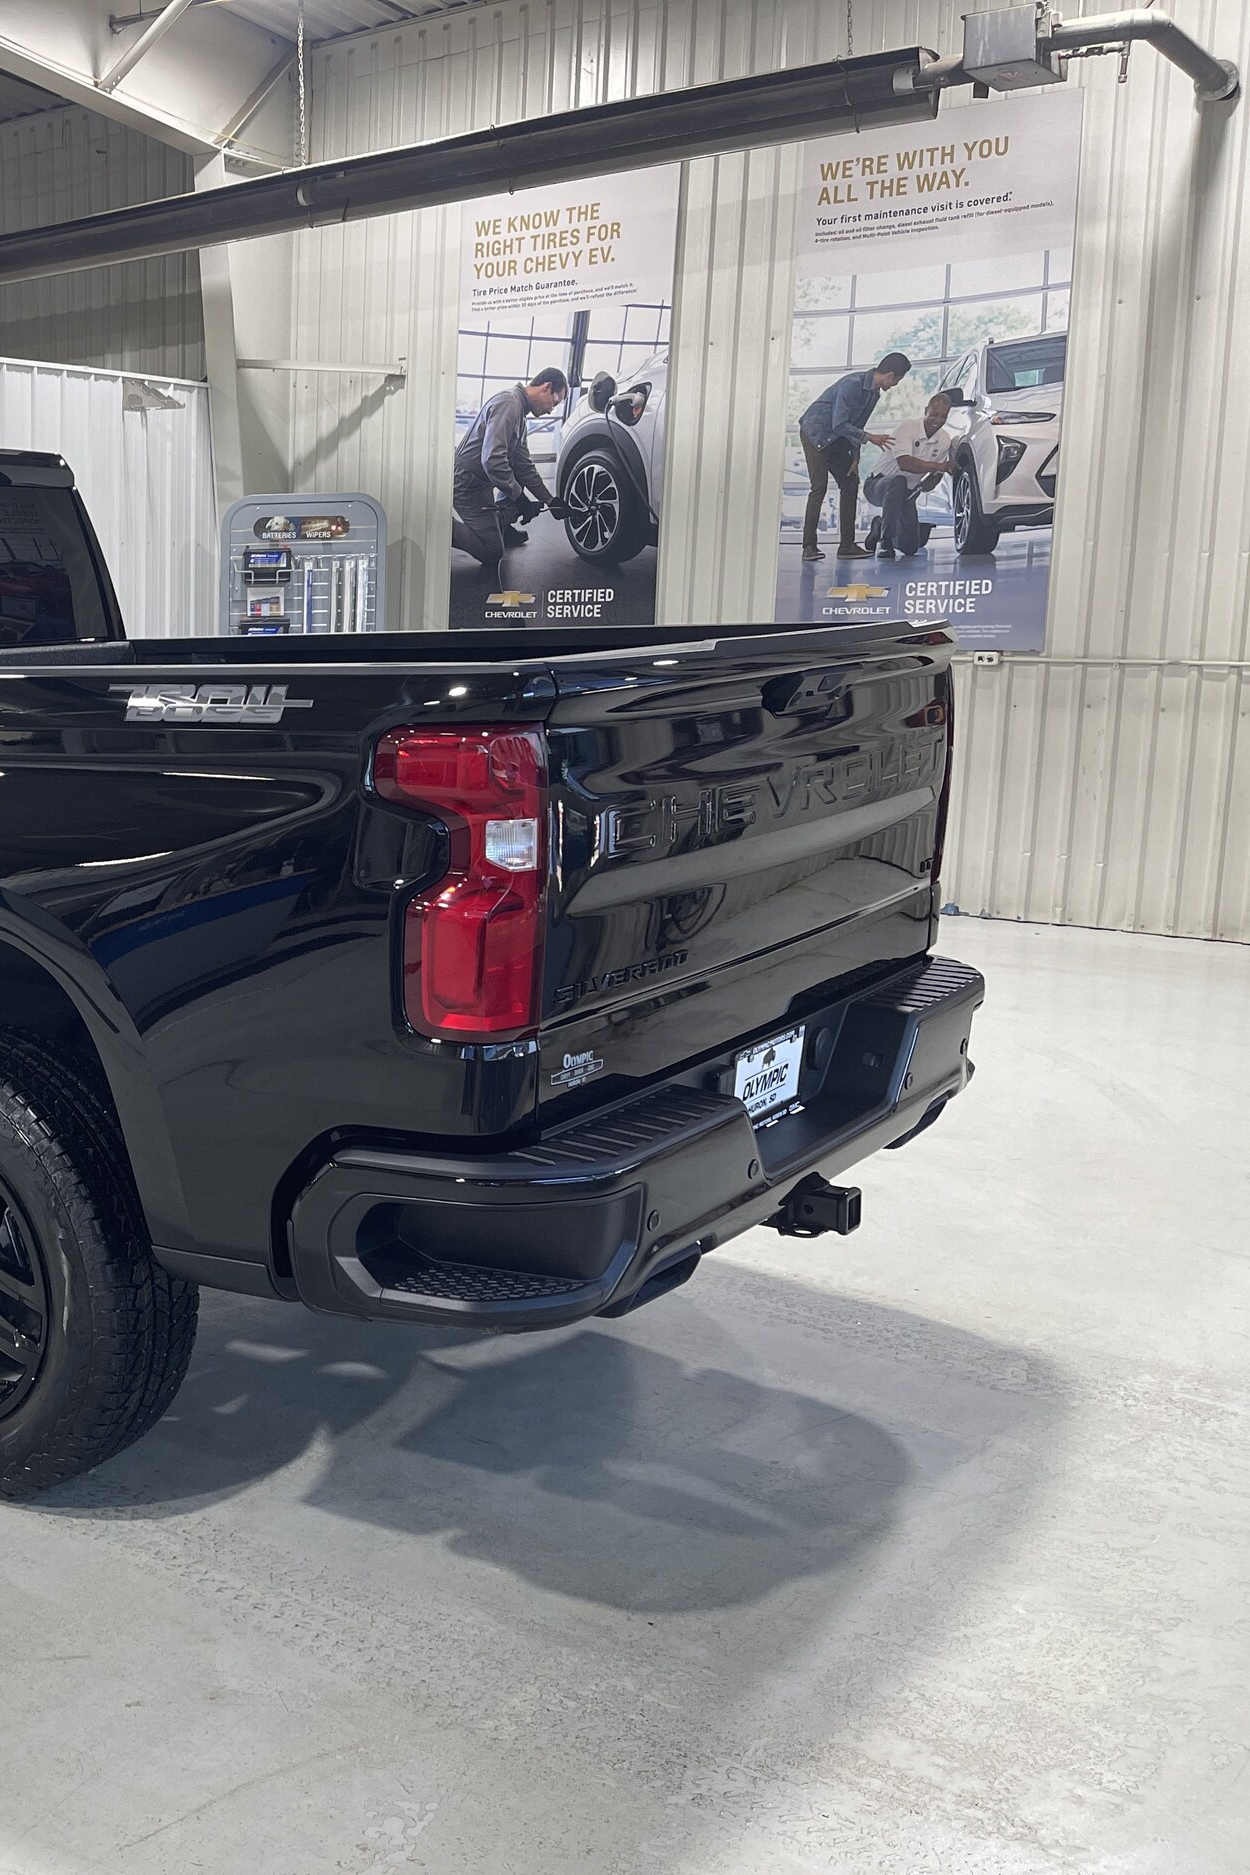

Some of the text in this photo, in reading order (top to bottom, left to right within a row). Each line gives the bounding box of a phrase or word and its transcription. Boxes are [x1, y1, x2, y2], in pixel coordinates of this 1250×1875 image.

[820, 136, 1010, 182] WE'RE WITH YOU
[817, 168, 969, 206] ALL THE WAY.
[475, 202, 601, 237] WE KNOW THE
[816, 217, 838, 226] Your
[840, 213, 862, 224] first
[864, 206, 928, 221] maintenance
[931, 201, 953, 212] visit
[955, 199, 964, 209] is
[474, 222, 621, 259] RIGHT TIRES FOR
[473, 245, 615, 280] YOUR CHEVY EV.
[472, 279, 578, 297] Tire Price Match Guarantee.
[262, 531, 331, 539] BATTERIES WIPERS
[547, 588, 614, 603] CERTIFIED
[905, 579, 993, 597] CERTIFIED
[485, 611, 537, 619] CHEVROLET
[547, 604, 602, 618] SERVICE
[822, 606, 891, 615] CHEVROLET
[904, 598, 976, 614] SERVICE
[607, 733, 944, 858] CHEVROLET
[554, 948, 688, 1003] SILVERADO
[743, 1063, 789, 1101] OLYMPIC
